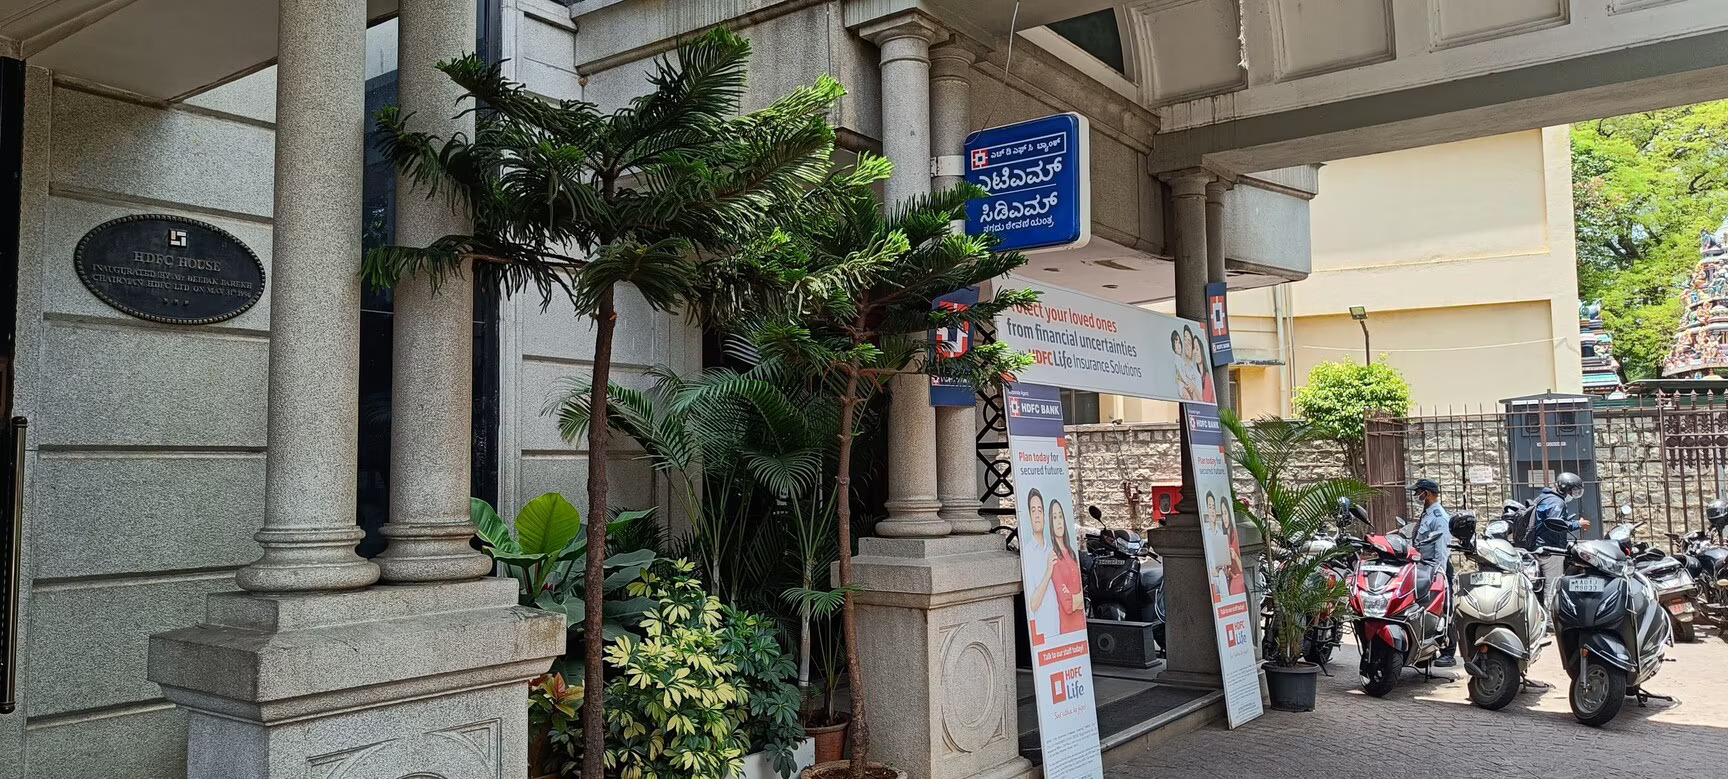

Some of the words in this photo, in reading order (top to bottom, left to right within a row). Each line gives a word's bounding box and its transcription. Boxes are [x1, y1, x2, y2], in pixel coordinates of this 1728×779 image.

[980, 191, 1058, 223] ಸಿಡಿಎಮ್
[133, 251, 174, 266] HDFC
[177, 256, 221, 271] HOUSE
[92, 263, 155, 278] INAUGURATED
[157, 271, 170, 280] BY
[187, 275, 218, 286] DEEPAK
[92, 273, 144, 286] CHAIRMAN
[174, 283, 190, 291] LTD
[193, 285, 204, 293] ON
[1045, 306, 1068, 324] your
[1069, 307, 1094, 328] loved
[1096, 316, 1117, 333] ones
[1006, 317, 1034, 339] from
[1035, 323, 1078, 347] financial
[1080, 335, 1137, 358] uncertainties
[1073, 354, 1110, 371] Insurance
[1110, 359, 1142, 378] Solutions
[1021, 402, 1040, 414] HDFC
[1041, 404, 1060, 415] BANK
[1019, 452, 1032, 462] Plan
[1032, 453, 1050, 465] today
[1050, 453, 1059, 462] for
[1020, 465, 1045, 476] secured
[1045, 466, 1065, 476] future.
[1065, 666, 1082, 681] HDFC
[1066, 680, 1084, 700] Life
